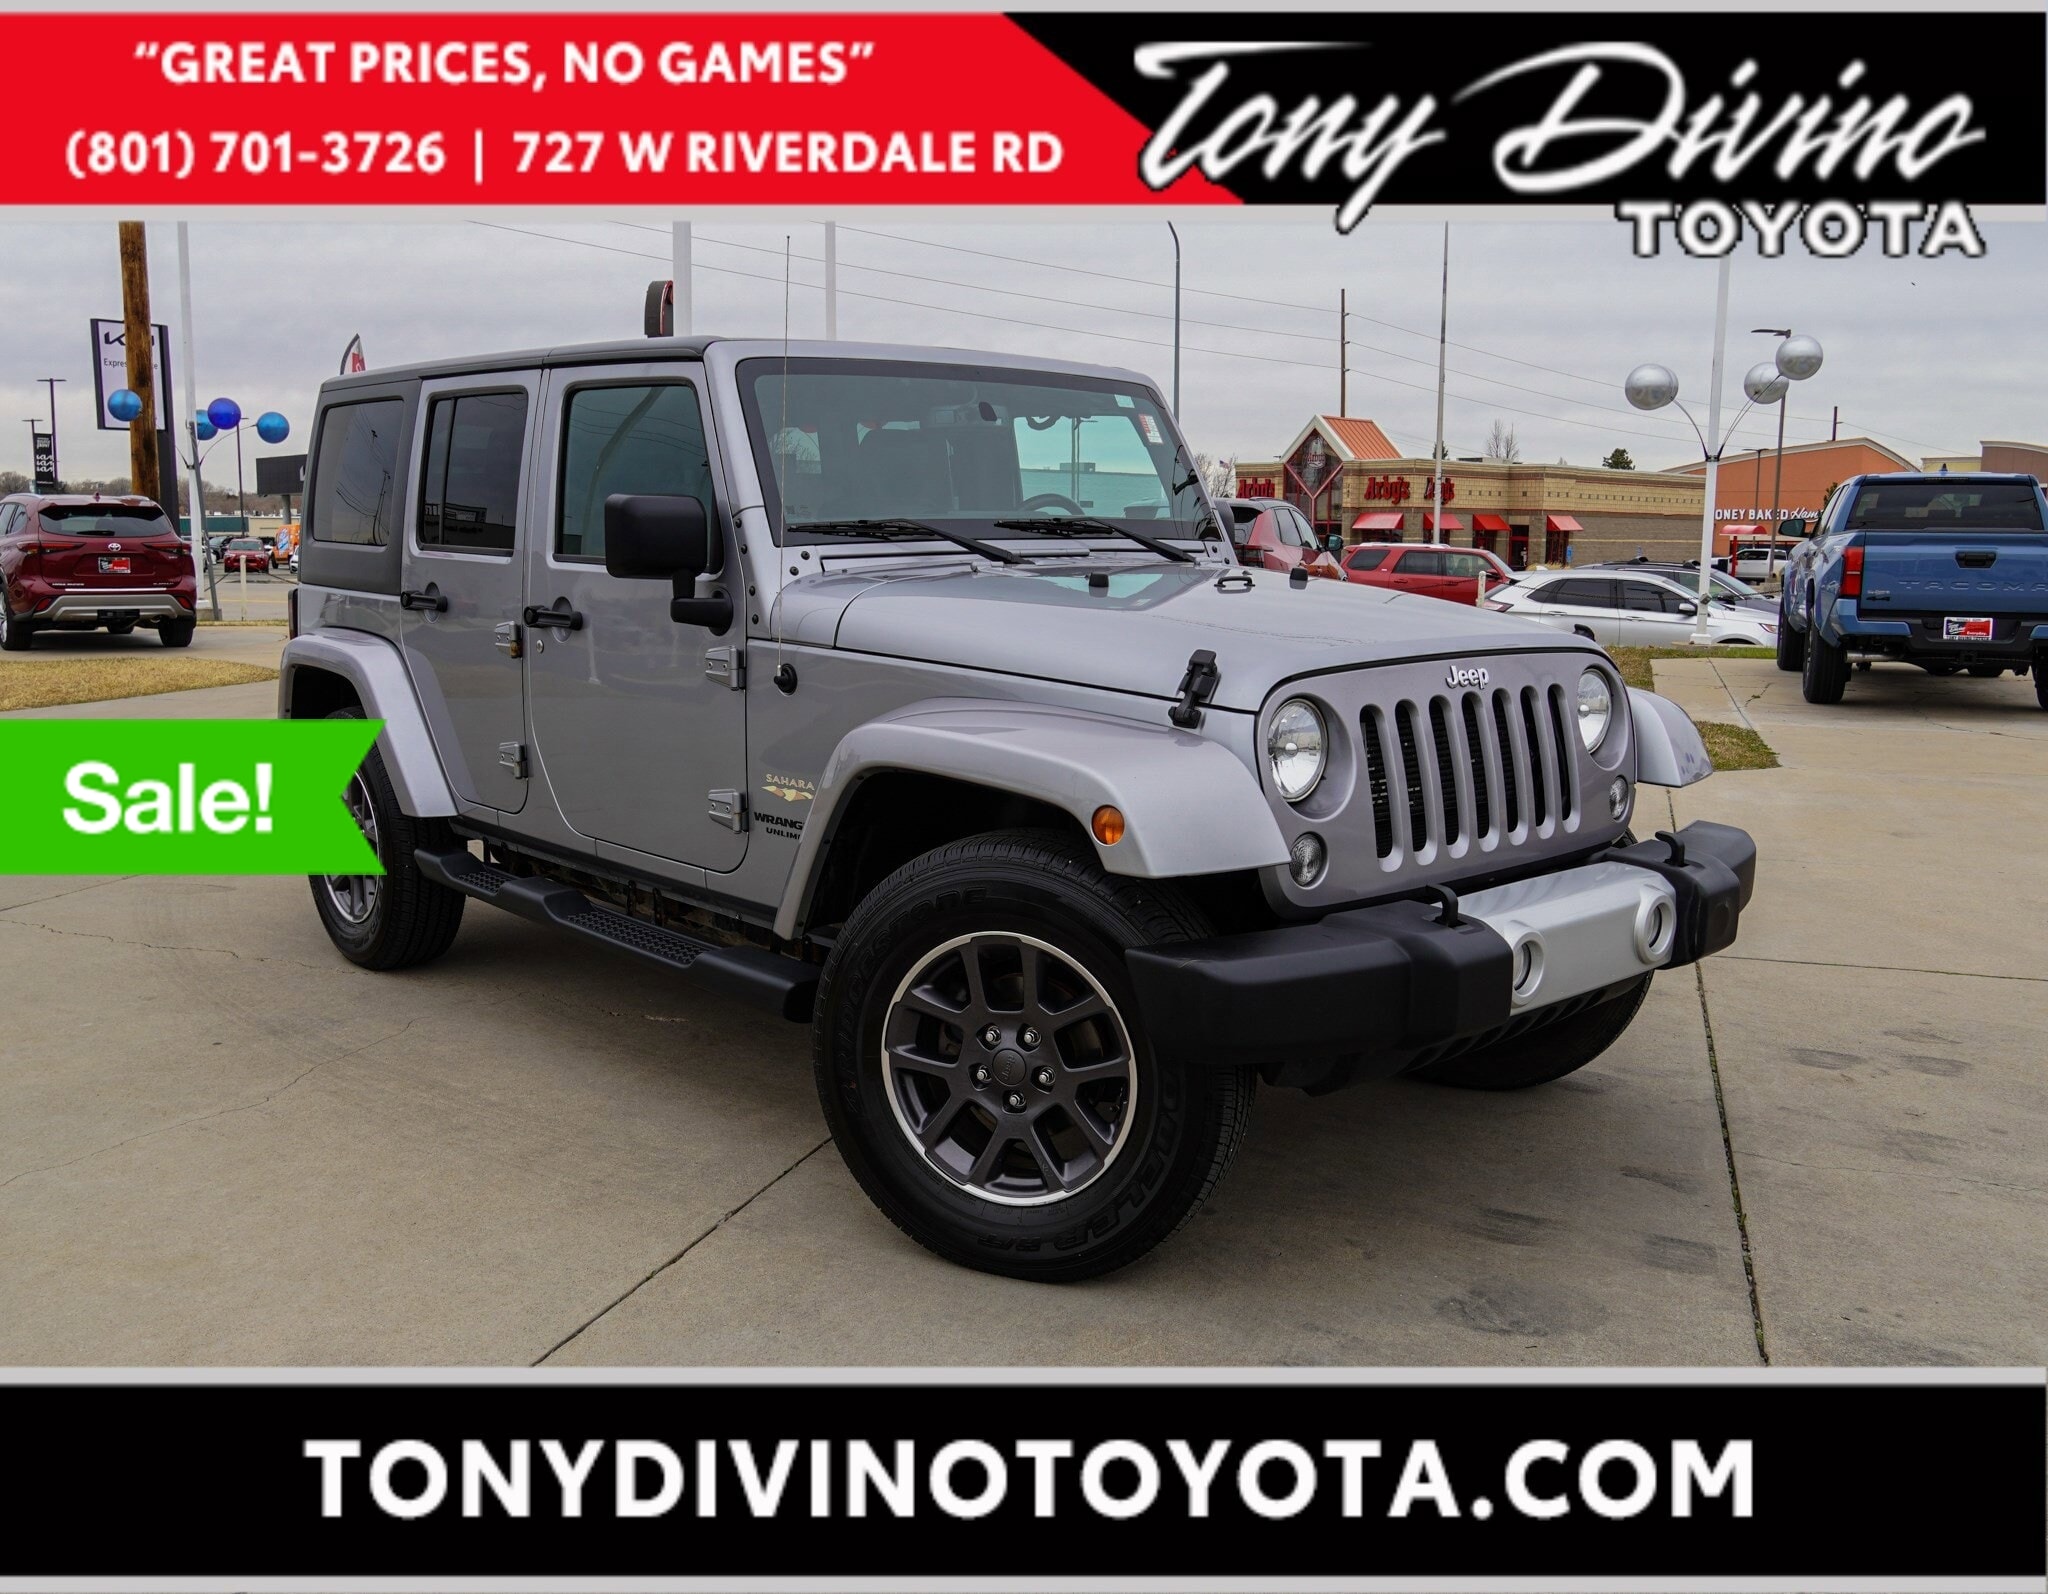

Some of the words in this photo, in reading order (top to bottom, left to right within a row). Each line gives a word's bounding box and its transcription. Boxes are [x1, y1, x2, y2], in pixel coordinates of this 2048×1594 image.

[1364, 475, 1410, 505] Arby's
[1898, 579, 2048, 592] TACOMA
[1445, 665, 1489, 690] Jeep
[765, 773, 815, 790] SAHARA
[754, 811, 805, 830] WRANG
